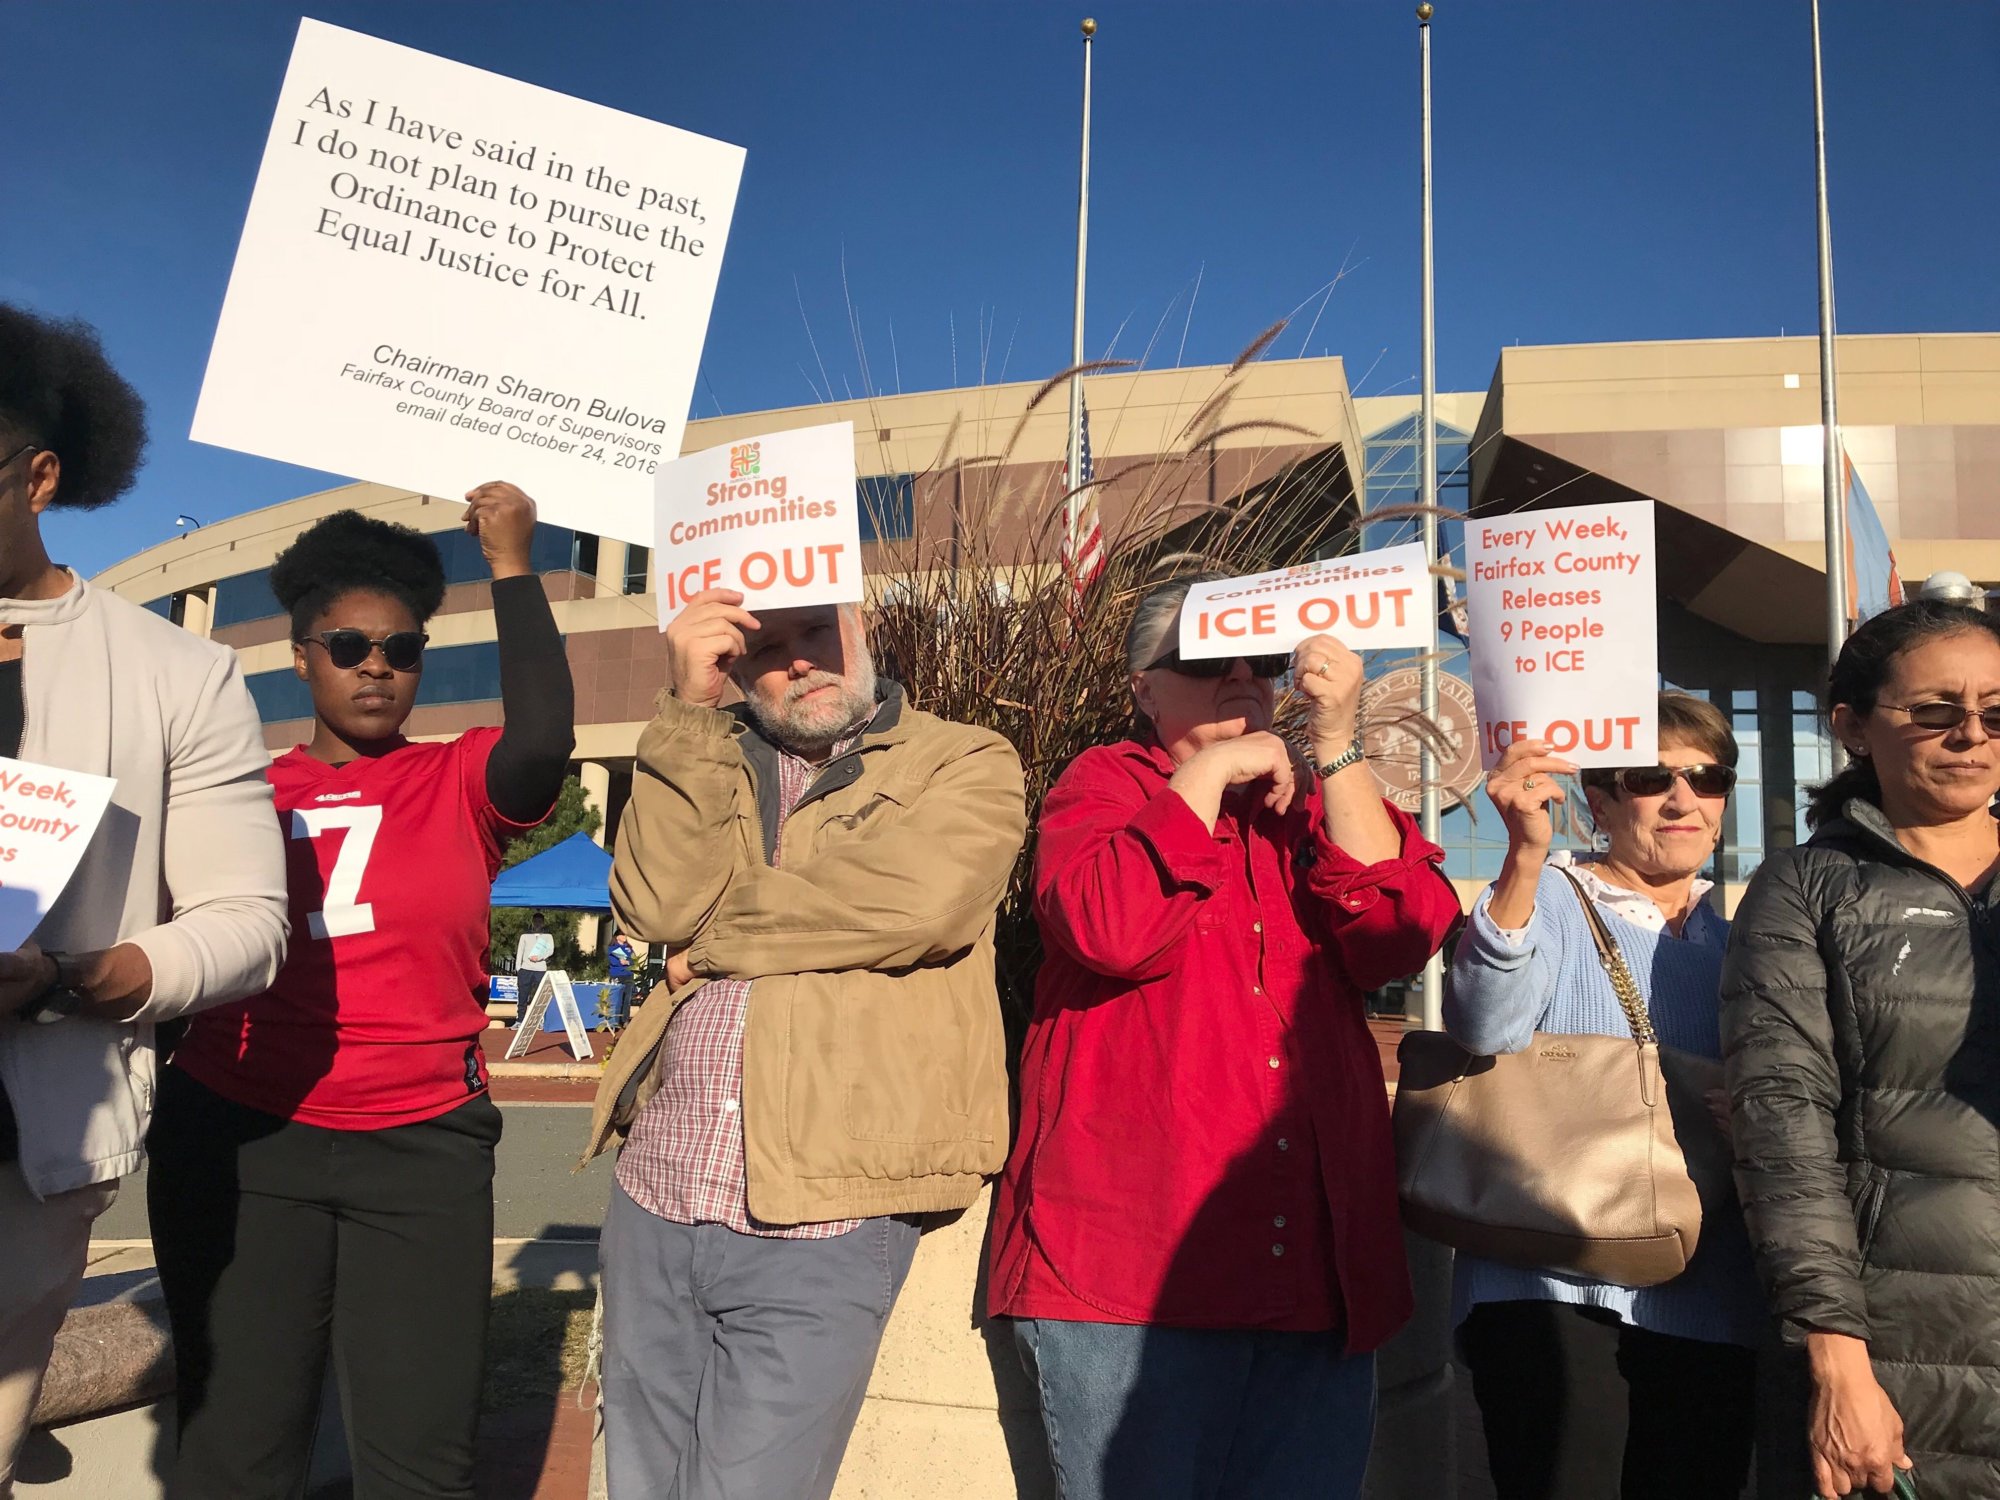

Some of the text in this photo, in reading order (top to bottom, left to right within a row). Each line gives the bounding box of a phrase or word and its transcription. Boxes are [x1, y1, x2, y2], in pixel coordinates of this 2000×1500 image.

[306, 86, 706, 224] As I have said in the past,
[293, 119, 705, 257] I do not plan to pursue the
[330, 172, 655, 283] Ordinance to Protect
[315, 207, 646, 320] Equal Justice for All.
[340, 363, 662, 455] Fairfax County Board of Supervisors
[373, 344, 666, 435] Chairman Sharon Bulova
[396, 401, 657, 476] email dated October 24, 2018
[706, 476, 787, 506] Strong
[669, 496, 837, 545] Communities
[1482, 516, 1628, 549] Every Week,
[667, 544, 844, 610] ICE OUT
[1205, 564, 1405, 601] Communities
[1258, 565, 1352, 585] Strong
[1474, 552, 1641, 582] Fairfax County
[1198, 588, 1413, 640] ICE OUT
[1502, 588, 1602, 610] Releases
[1500, 617, 1604, 644] 9 People
[1515, 650, 1585, 673] to ICE
[1486, 716, 1641, 754] ICE OUT
[291, 805, 383, 940] 7
